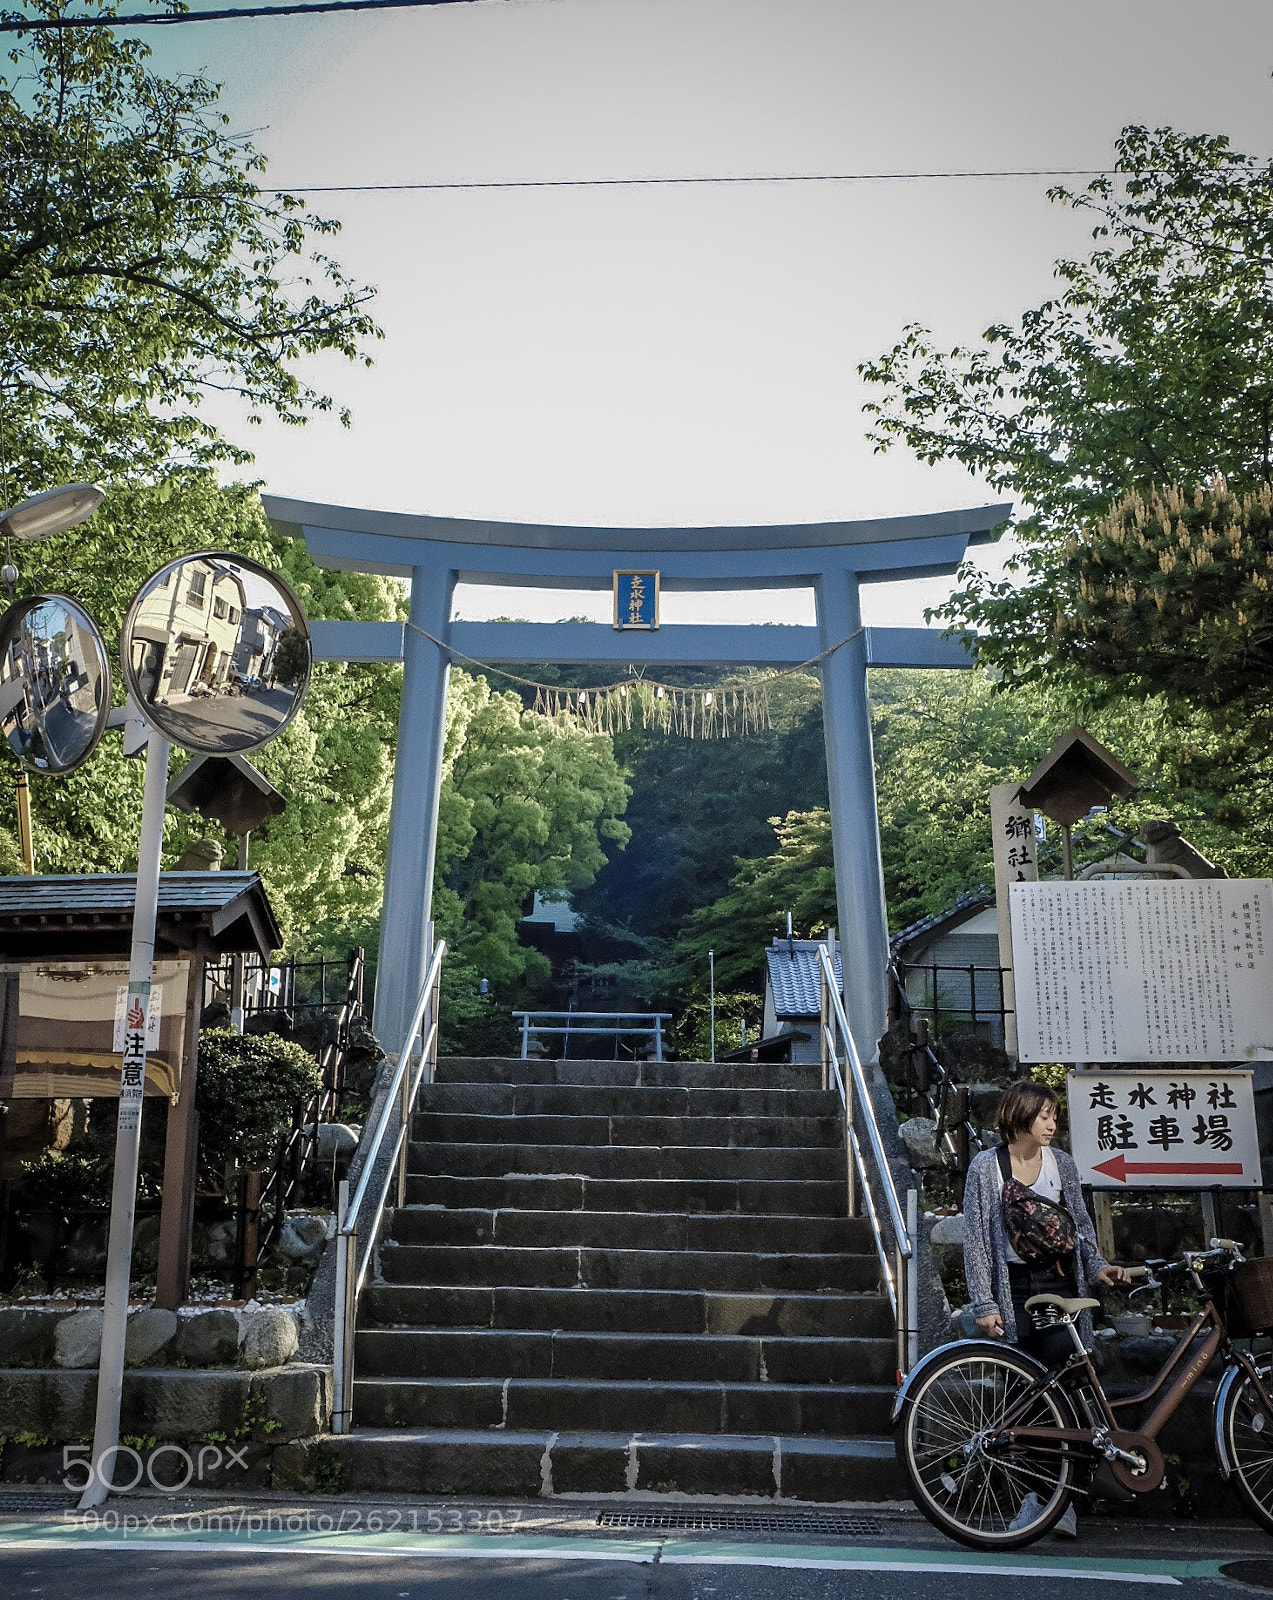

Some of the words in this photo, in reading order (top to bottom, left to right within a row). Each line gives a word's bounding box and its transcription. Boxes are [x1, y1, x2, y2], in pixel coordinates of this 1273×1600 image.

[628, 575, 646, 624] 走水神社
[1230, 910, 1243, 969] 走水神社
[122, 1033, 144, 1086] 注意
[1089, 1082, 1237, 1110] 走水神社
[1097, 1114, 1234, 1152] 駐車場
